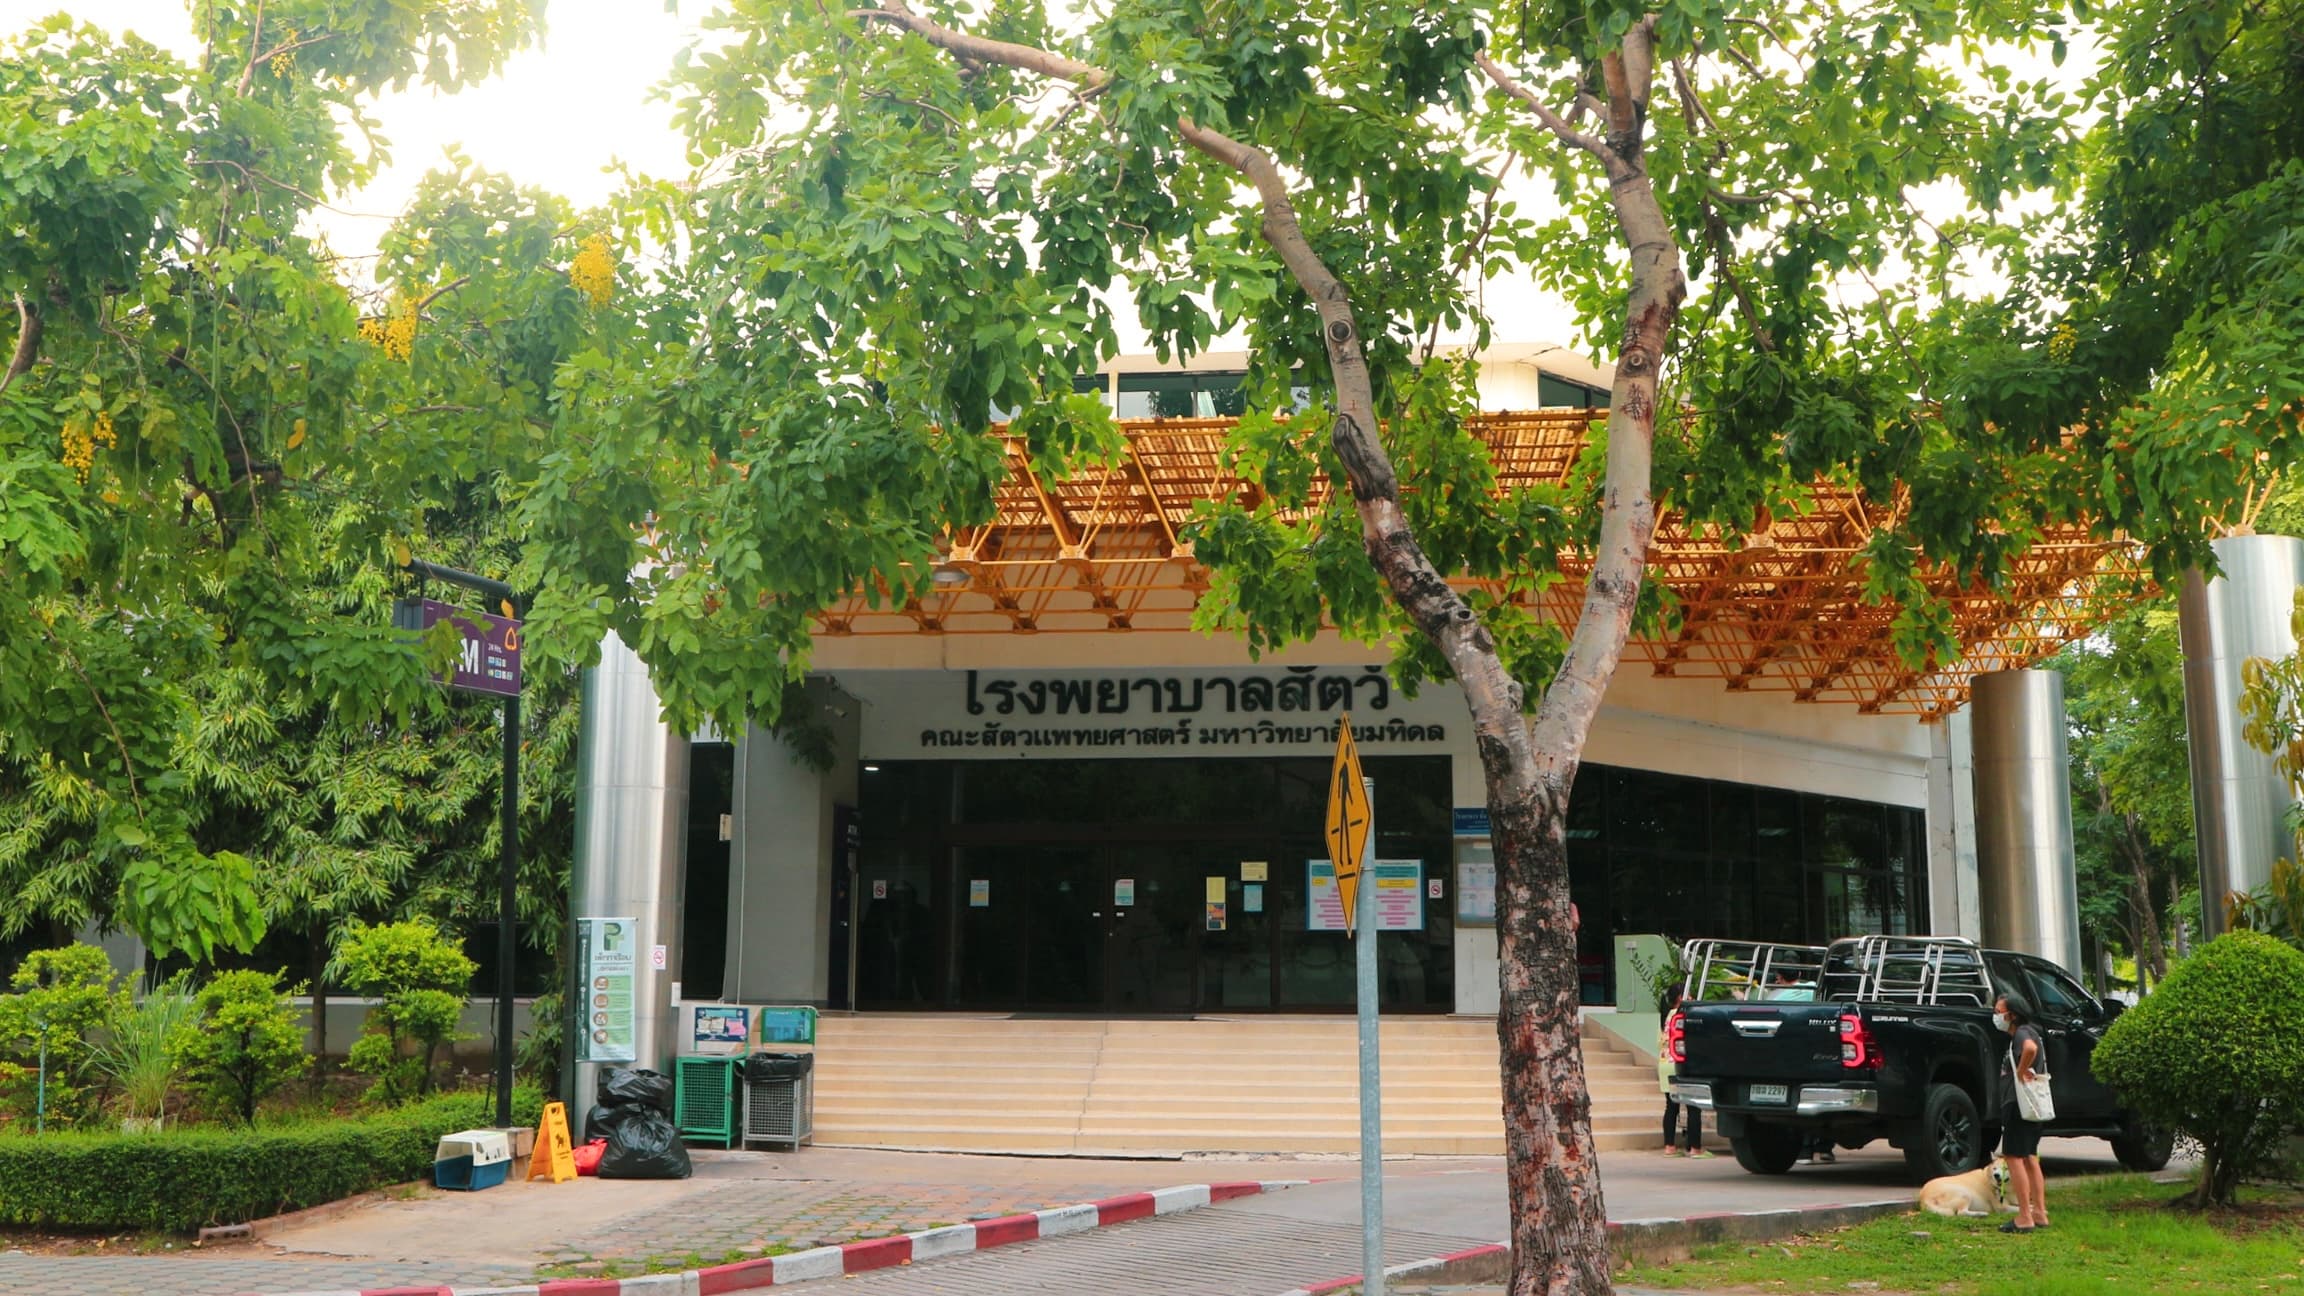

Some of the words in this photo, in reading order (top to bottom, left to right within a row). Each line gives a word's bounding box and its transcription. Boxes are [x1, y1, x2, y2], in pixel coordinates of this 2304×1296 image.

[920, 718, 1192, 747] คณะสัตวแพทยศาสตร์
